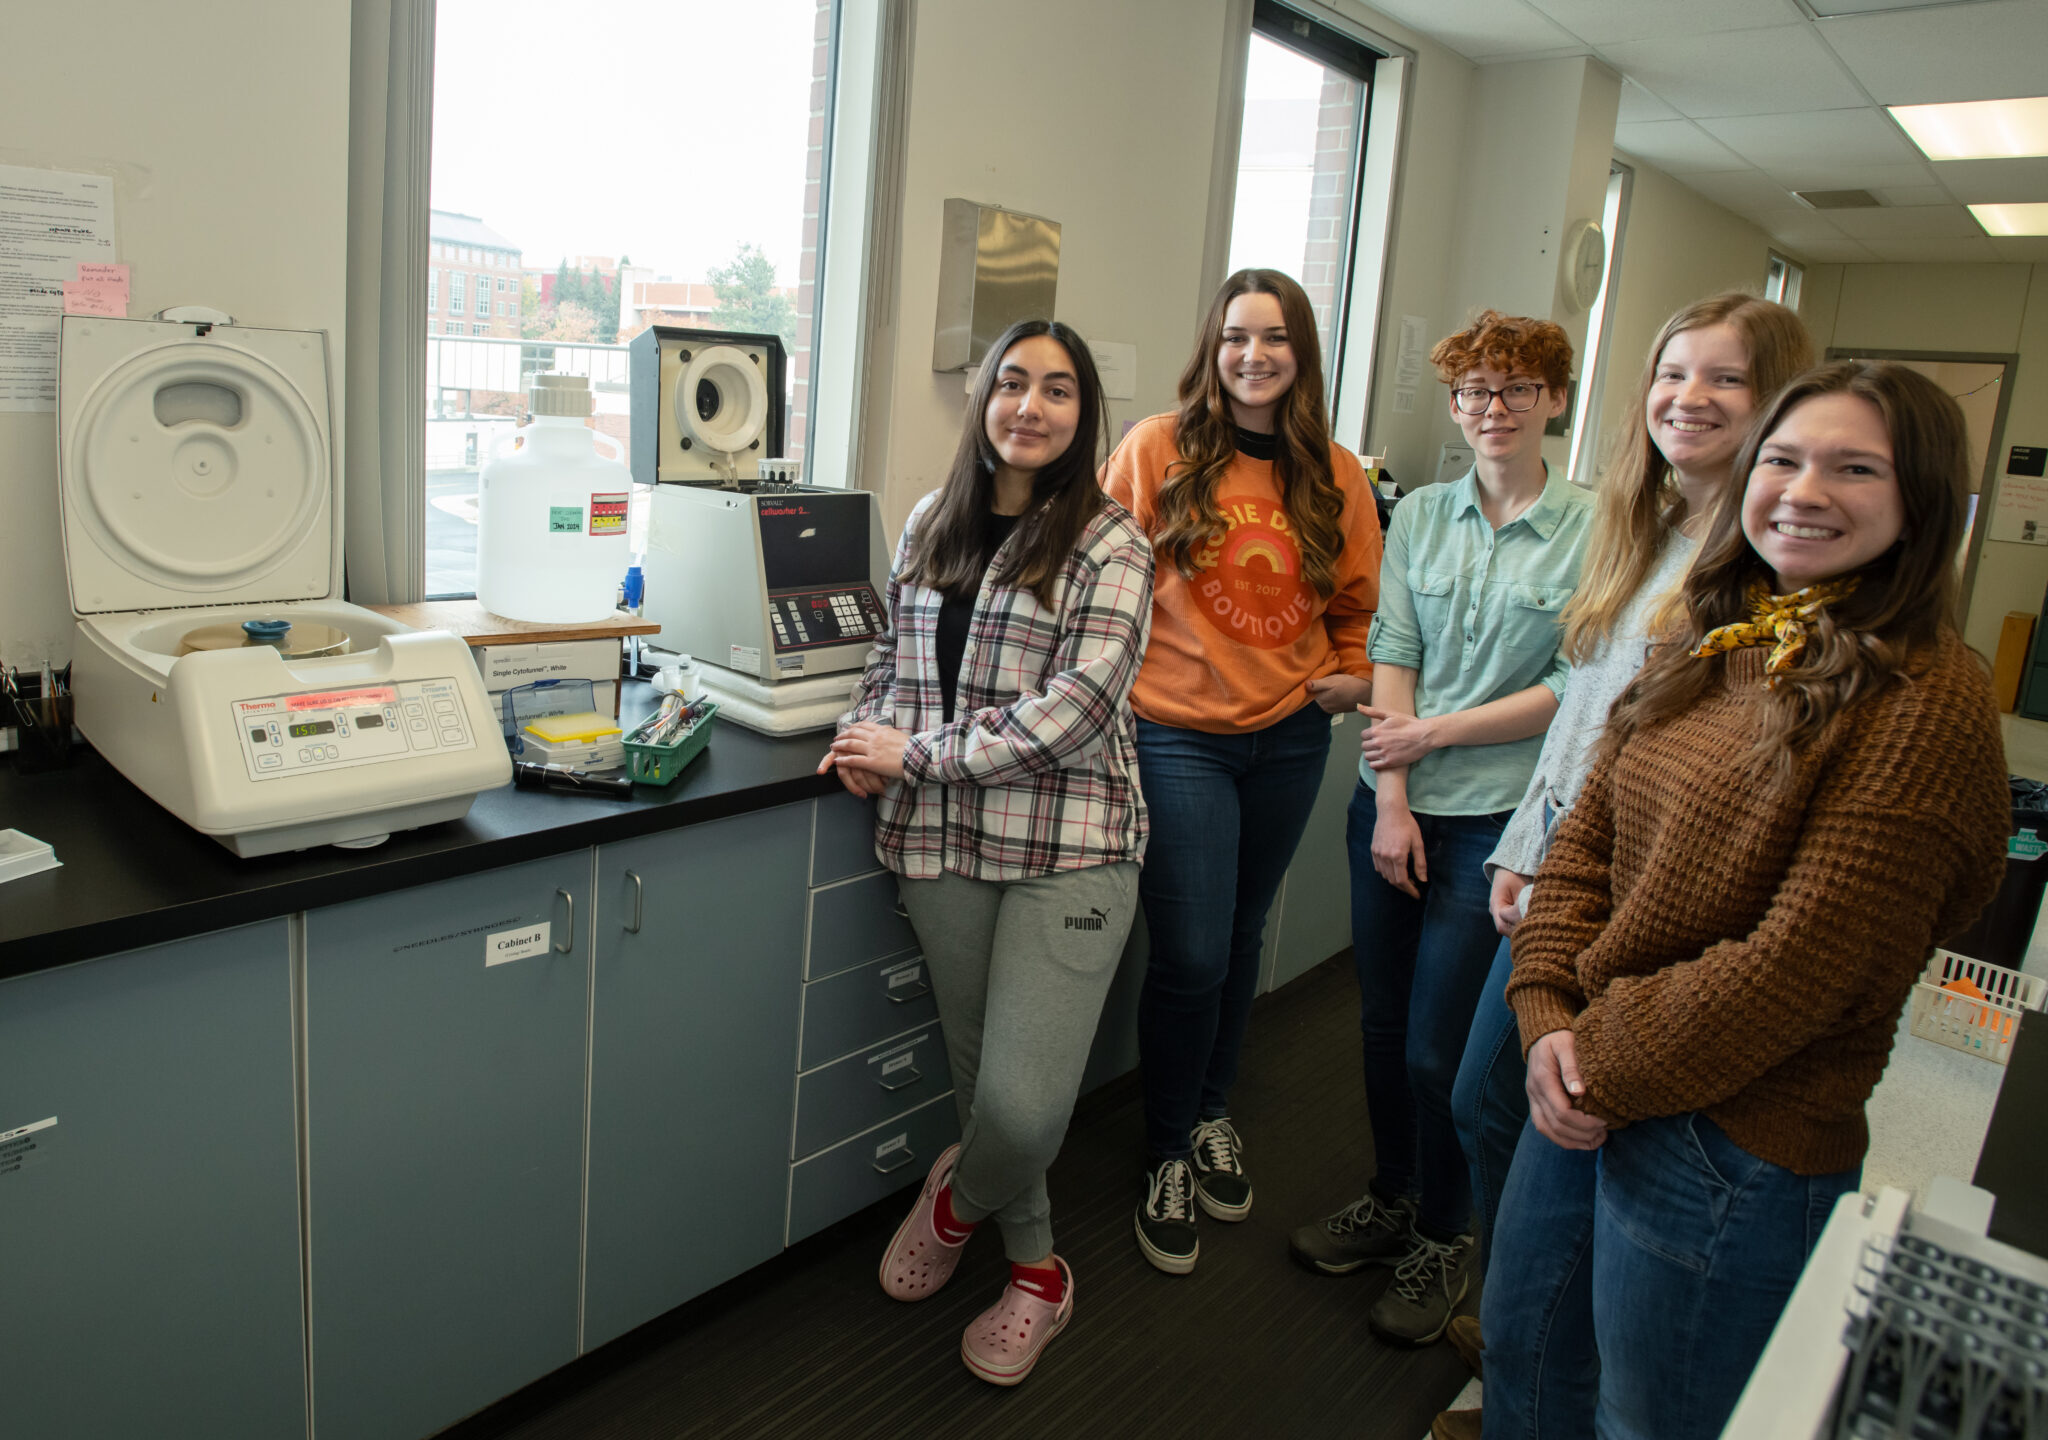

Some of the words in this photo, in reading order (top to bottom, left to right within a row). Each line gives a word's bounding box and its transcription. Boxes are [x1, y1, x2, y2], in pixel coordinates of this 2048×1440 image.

[1234, 579, 1252, 592] EST.
[1255, 584, 1281, 597] 2017
[1201, 579, 1312, 640] BOUTIQUE
[240, 702, 276, 711] Thermo
[1064, 916, 1102, 931] PUMA
[497, 936, 532, 950] Cabinet
[534, 933, 541, 942] B
